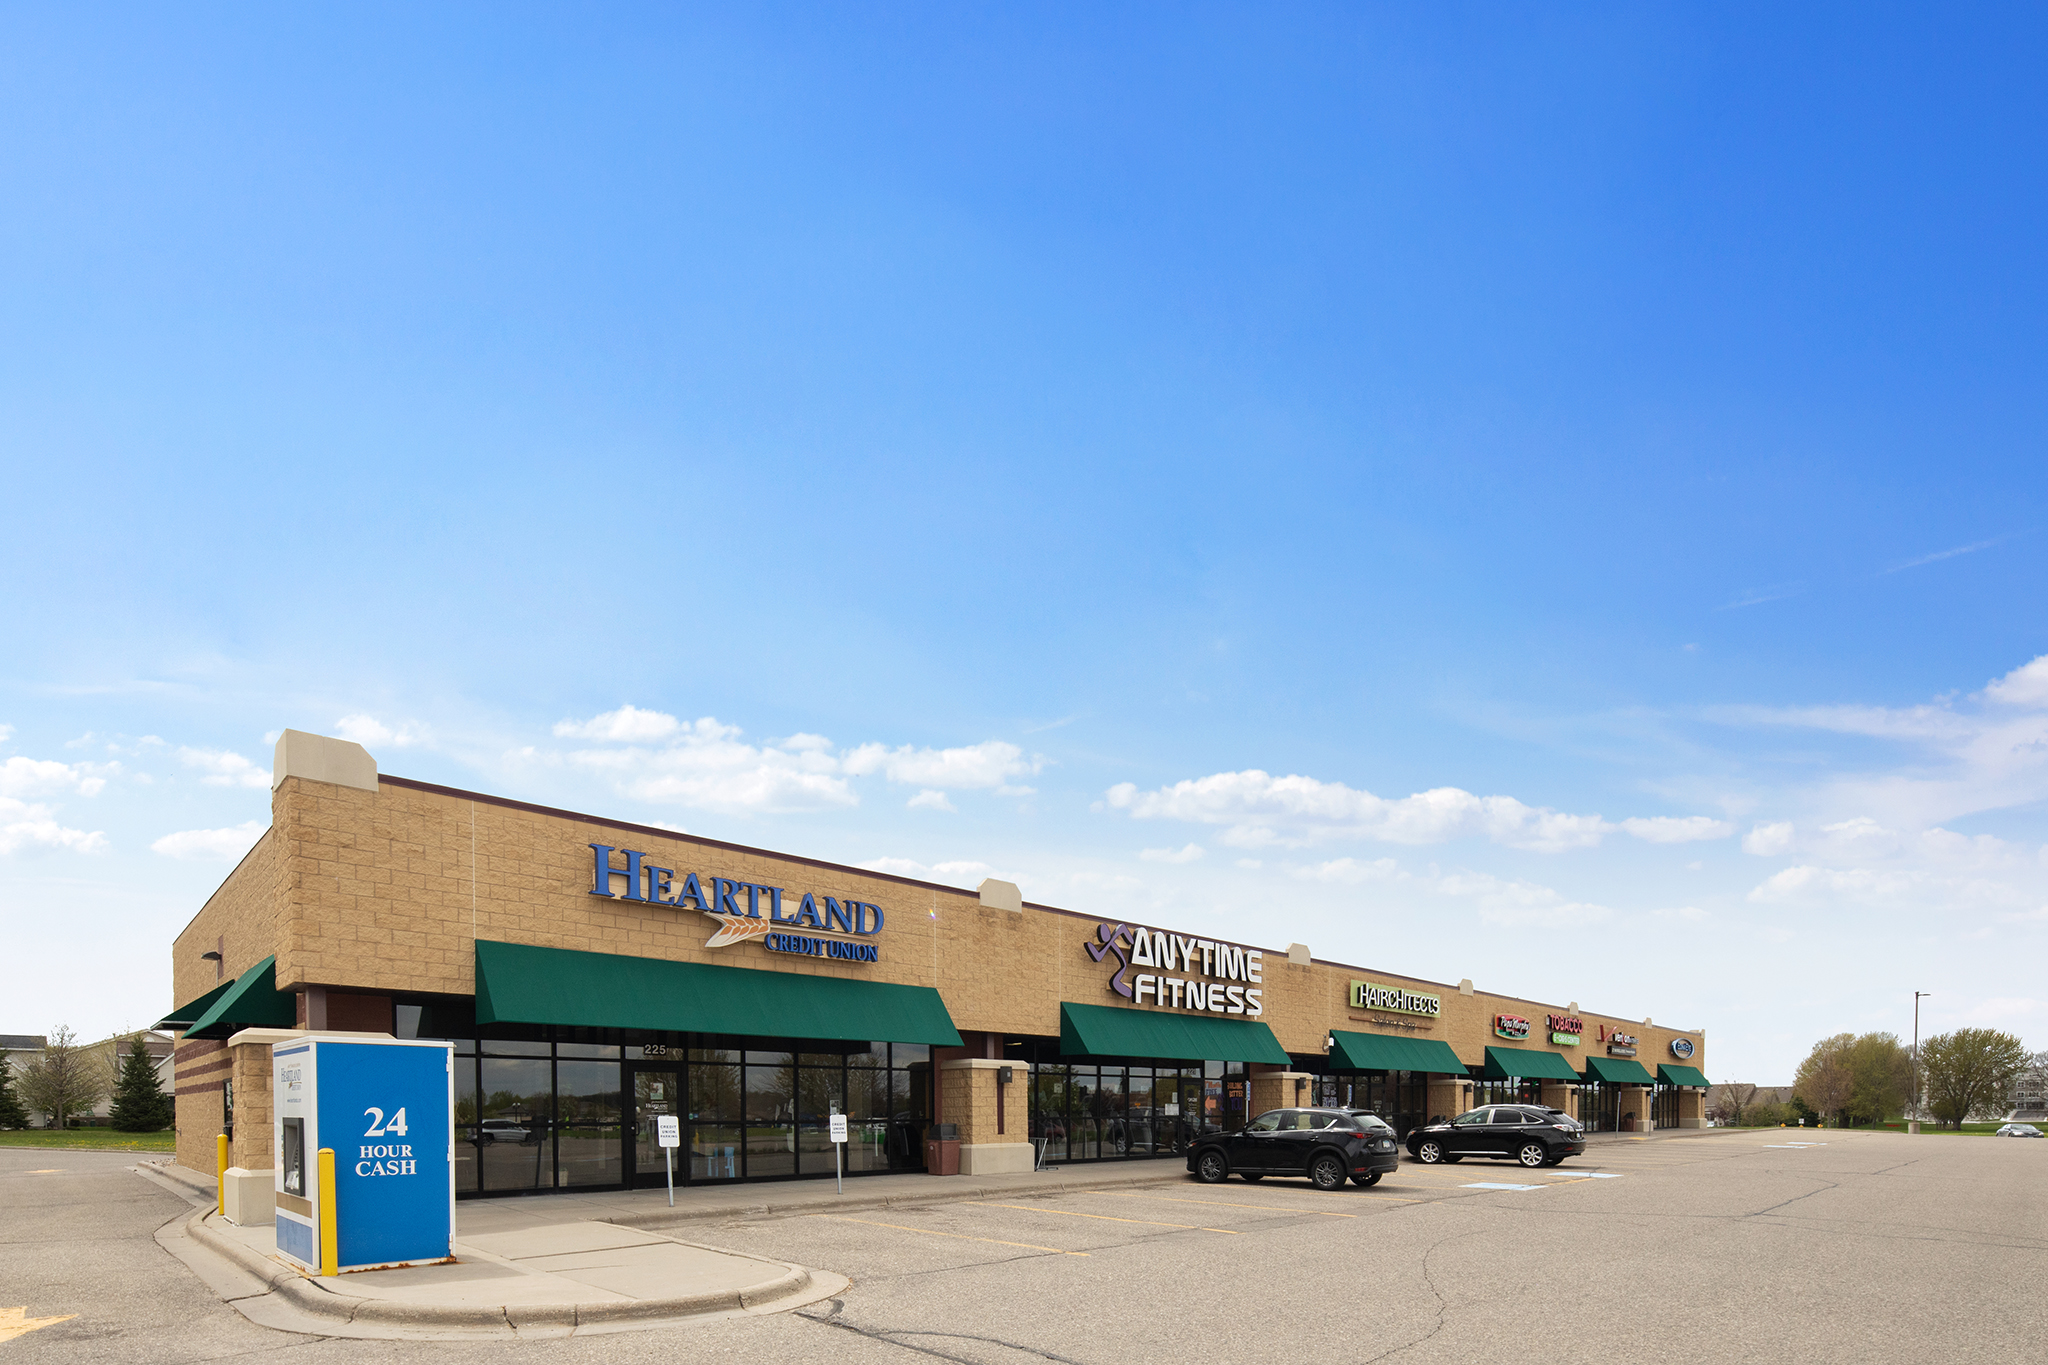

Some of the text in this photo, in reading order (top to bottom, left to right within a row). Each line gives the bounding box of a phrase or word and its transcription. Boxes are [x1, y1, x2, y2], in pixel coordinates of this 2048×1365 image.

[588, 843, 885, 935] HEARTLAND
[763, 932, 879, 963] CREDIT UNION
[1131, 926, 1263, 984] ANYTIME
[1133, 973, 1263, 1016] FITNESS
[1550, 1014, 1584, 1034] TOBACCO
[644, 1044, 666, 1055] 225
[363, 1106, 409, 1137] 24
[359, 1144, 413, 1158] HOUR
[355, 1160, 417, 1177] CASH
